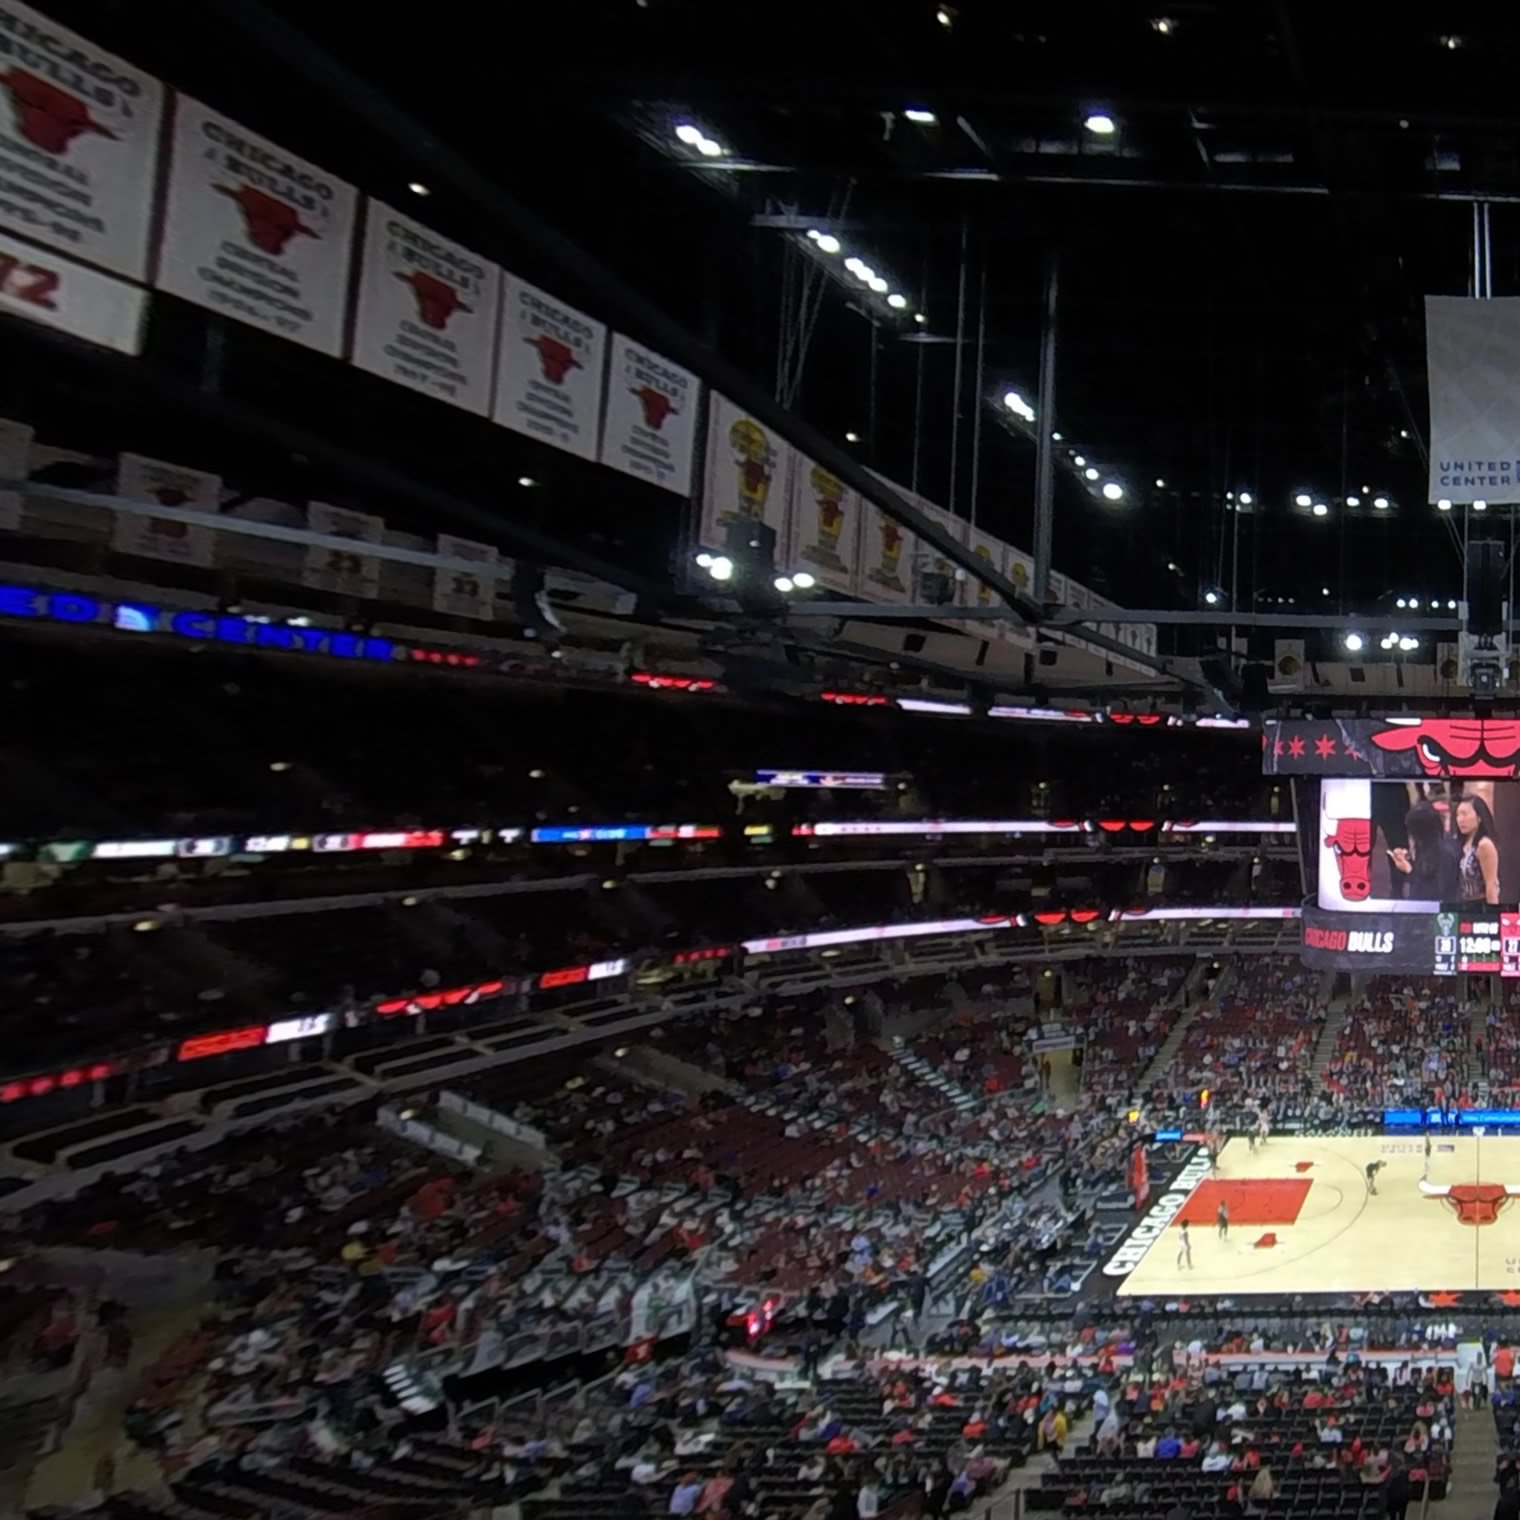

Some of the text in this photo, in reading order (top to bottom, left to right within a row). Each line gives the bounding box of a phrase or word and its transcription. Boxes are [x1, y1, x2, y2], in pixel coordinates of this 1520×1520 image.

[201, 120, 334, 200] CHICAGO
[1440, 461, 1511, 472] UNITED
[1440, 476, 1511, 486] CENTER
[171, 609, 395, 662] CENTER
[1347, 931, 1394, 953] BULLS
[1103, 1193, 1186, 1276] CHICAGO
